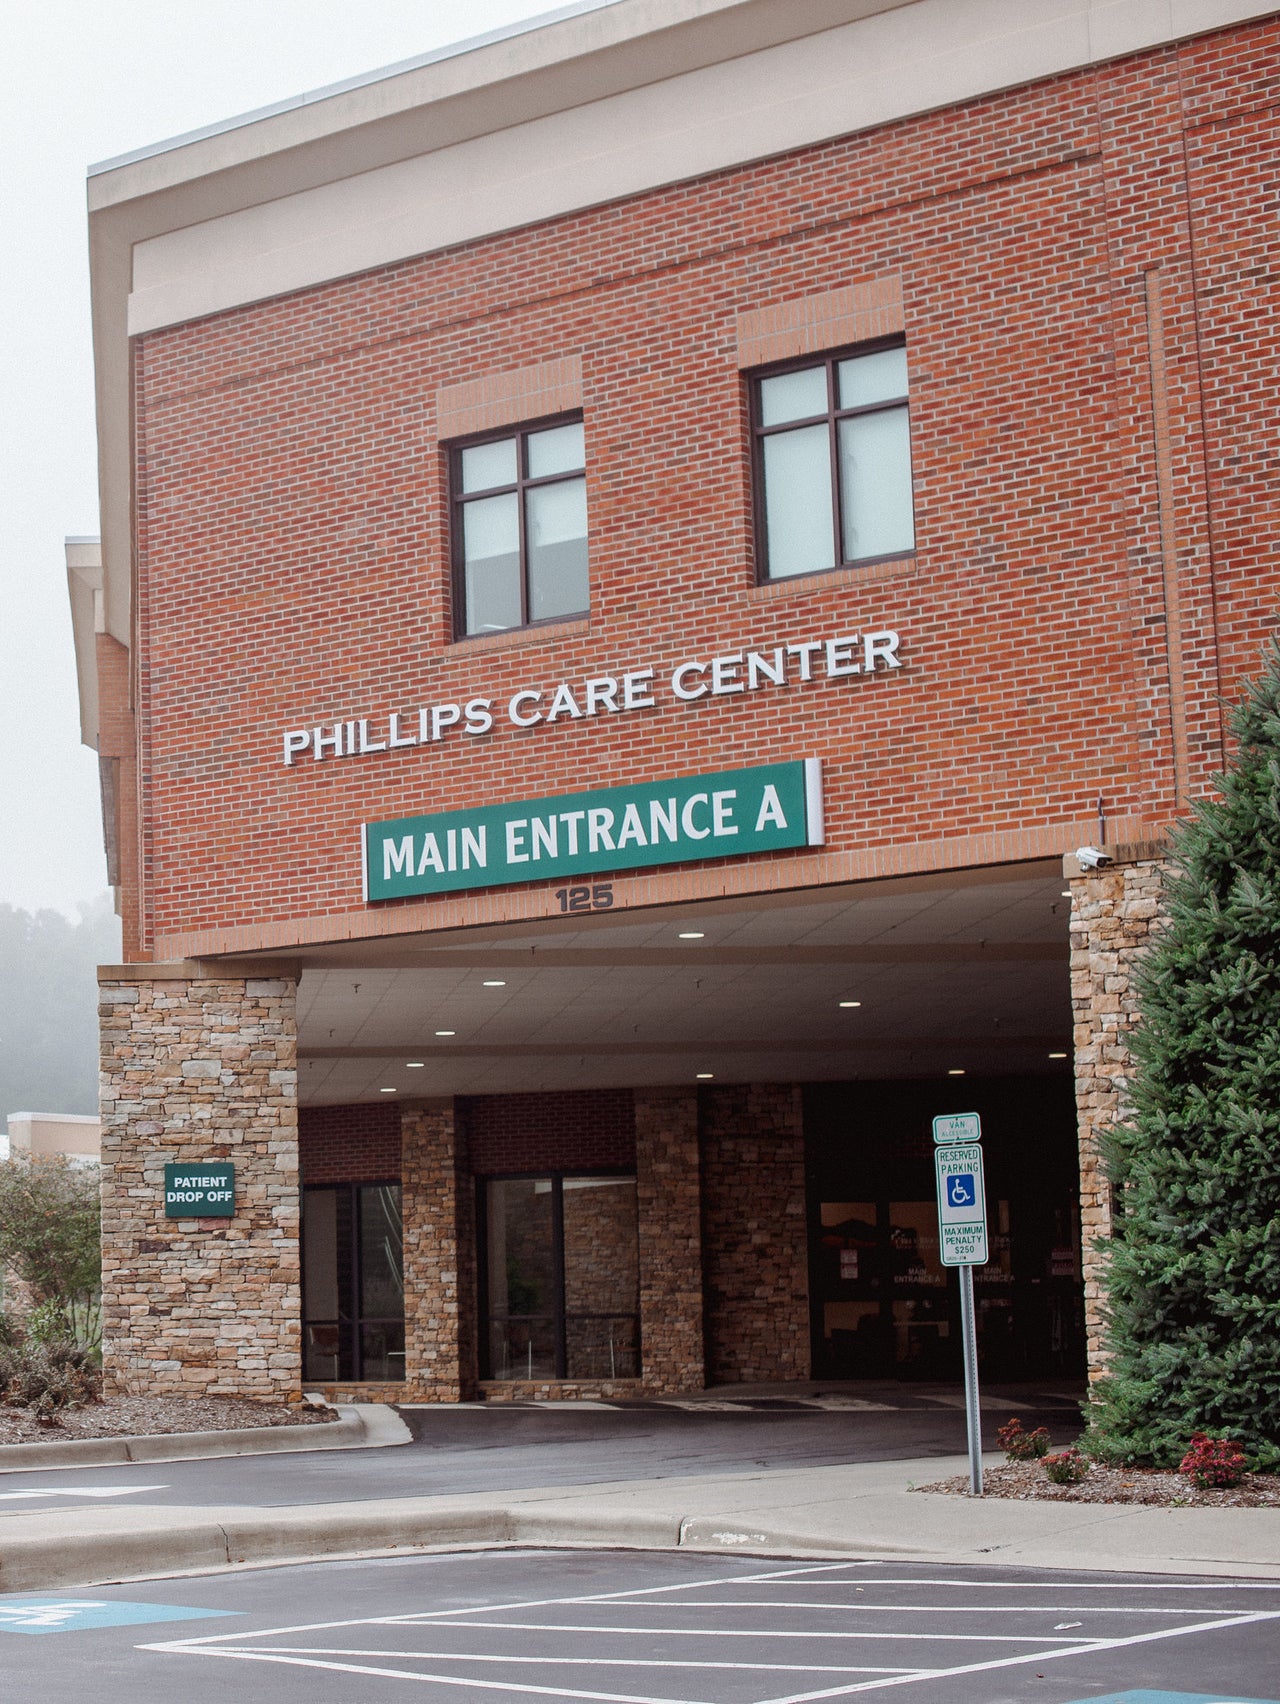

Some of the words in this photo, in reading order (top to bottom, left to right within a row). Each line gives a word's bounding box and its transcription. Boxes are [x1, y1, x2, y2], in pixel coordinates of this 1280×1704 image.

[283, 698, 493, 765] PHILLIPS
[509, 668, 656, 727] CARE
[672, 630, 902, 699] CENTER
[382, 825, 487, 880] MAIN
[506, 789, 739, 864] ENTRANCE
[756, 784, 788, 832] A
[555, 884, 613, 912] 125
[949, 1120, 965, 1129] VAN
[940, 1149, 978, 1162] RESERVED
[941, 1162, 979, 1174] PARKING
[174, 1177, 227, 1188] PATIENT
[167, 1191, 203, 1203] DROP
[207, 1191, 232, 1202] OFF
[944, 1226, 983, 1236] MAXIMUM
[946, 1235, 982, 1245] PENALTY
[955, 1245, 975, 1254] $250
[908, 1267, 927, 1275] MAIN
[894, 1275, 933, 1283] ENTRANCE
[974, 1275, 1009, 1283] NTRANCE
